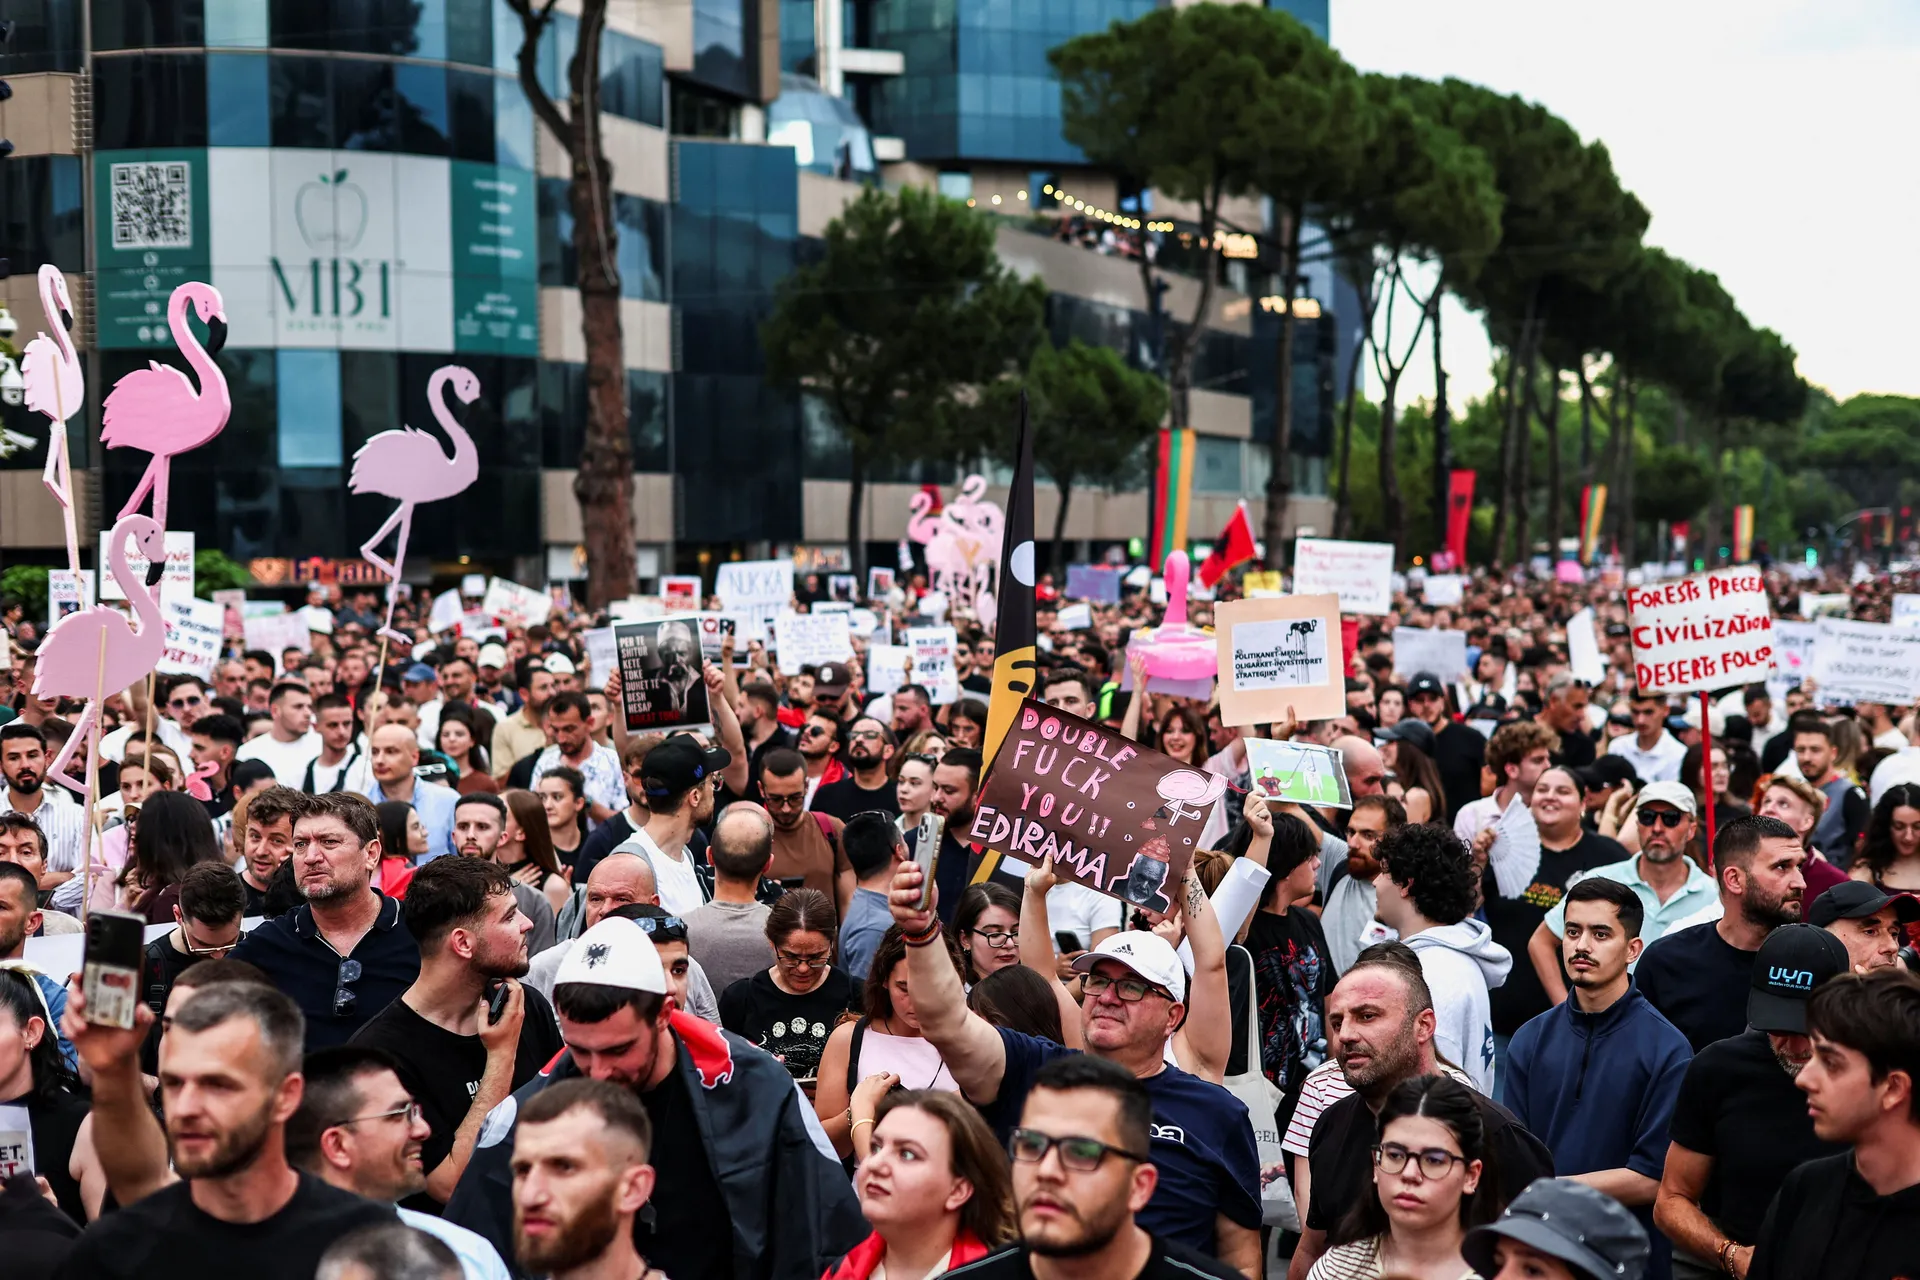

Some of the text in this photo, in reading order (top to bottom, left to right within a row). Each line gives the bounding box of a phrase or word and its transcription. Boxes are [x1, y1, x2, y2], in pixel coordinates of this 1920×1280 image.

[620, 635, 645, 648] PER TE
[621, 646, 648, 658] SHITUR
[623, 658, 640, 669] KETE
[624, 669, 643, 680] TOKE
[1235, 670, 1278, 679] STRATEGJIKE
[625, 679, 660, 691] DUHET TE
[626, 692, 646, 702] BESH
[628, 702, 652, 713] HESAP
[1021, 707, 1138, 771] DOUBLE
[1012, 740, 1111, 800] FUCK
